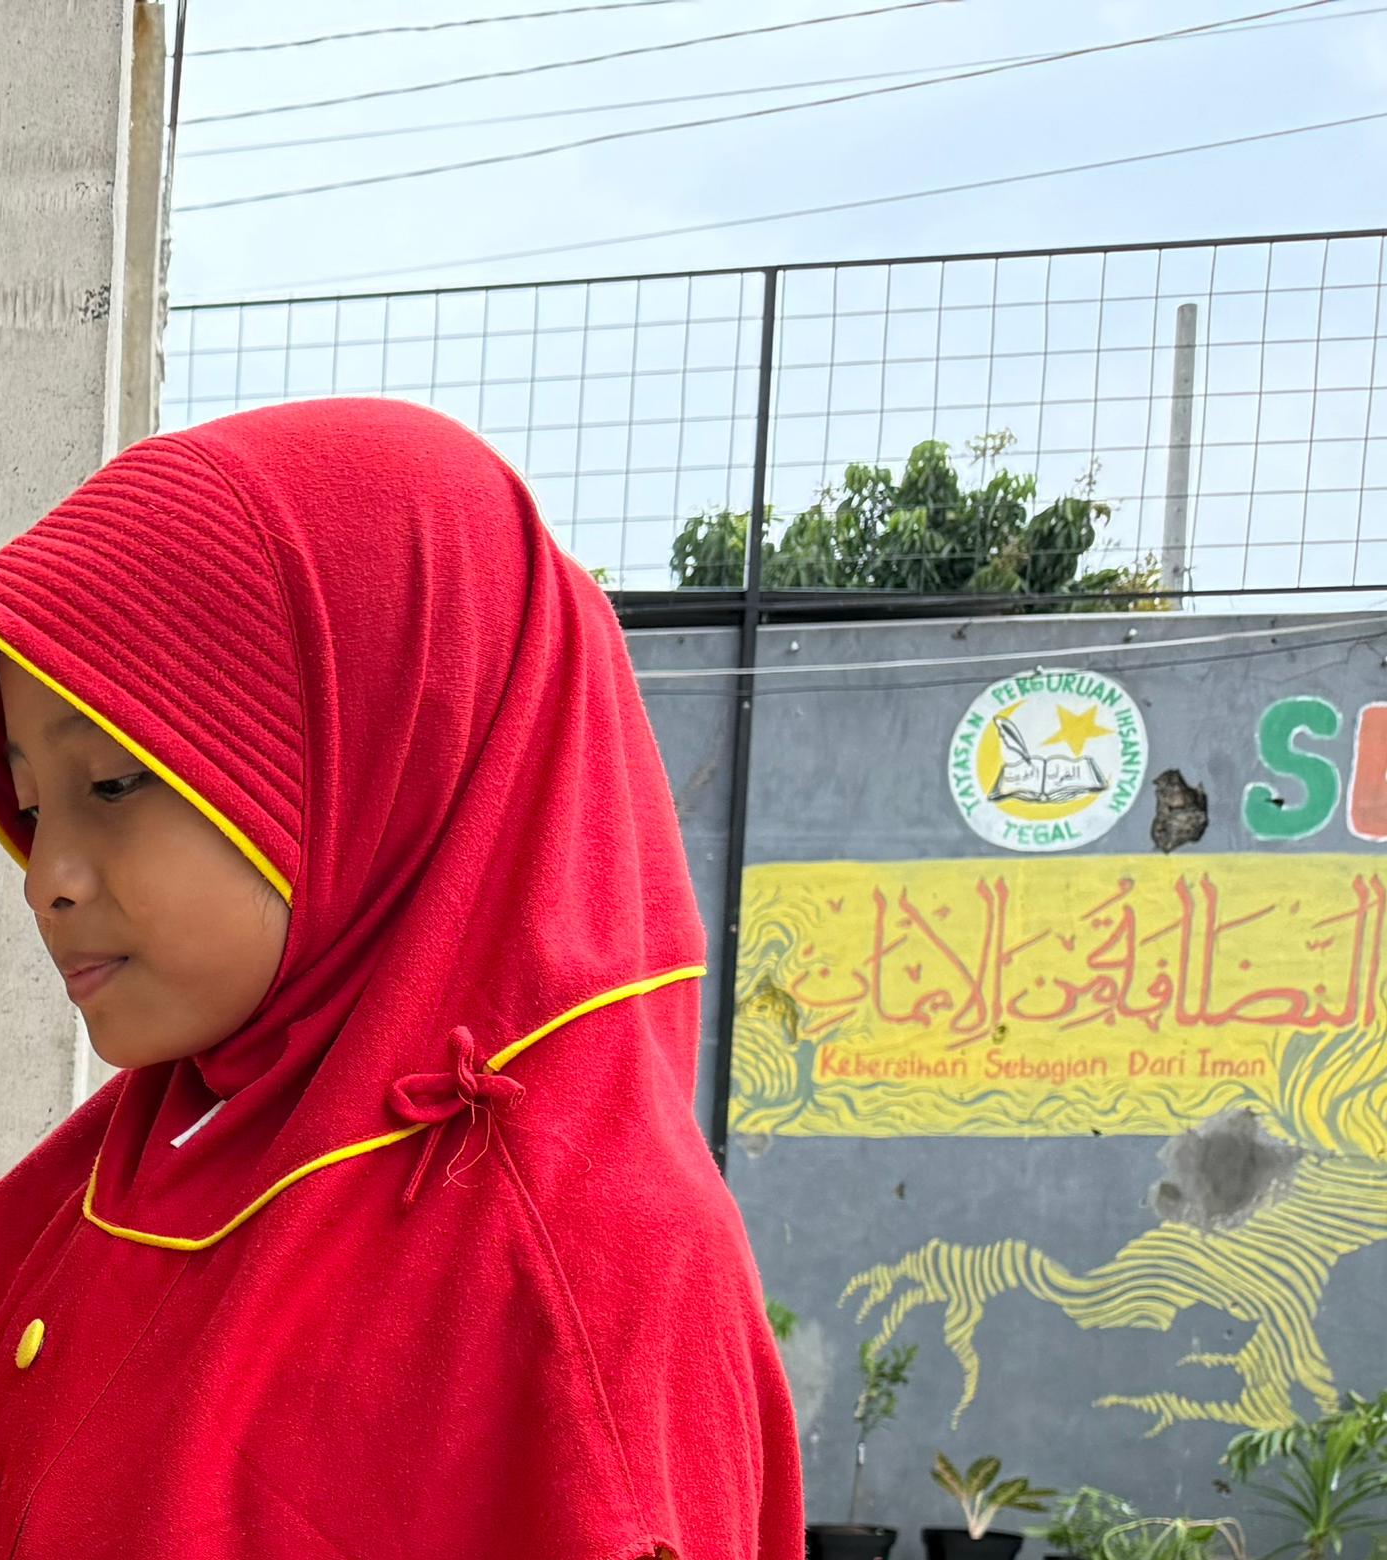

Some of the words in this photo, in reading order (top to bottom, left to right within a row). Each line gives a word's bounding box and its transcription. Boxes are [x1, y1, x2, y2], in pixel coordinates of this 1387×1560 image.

[991, 672, 1122, 707] PERGURUAN
[1109, 708, 1142, 813] IHSANIYAH
[1002, 820, 1082, 845] TEGAL
[818, 1045, 968, 1081] Kebersihan
[983, 1050, 1108, 1086] Sebagian
[1128, 1049, 1185, 1076] Dari
[1197, 1048, 1266, 1077] Iman
